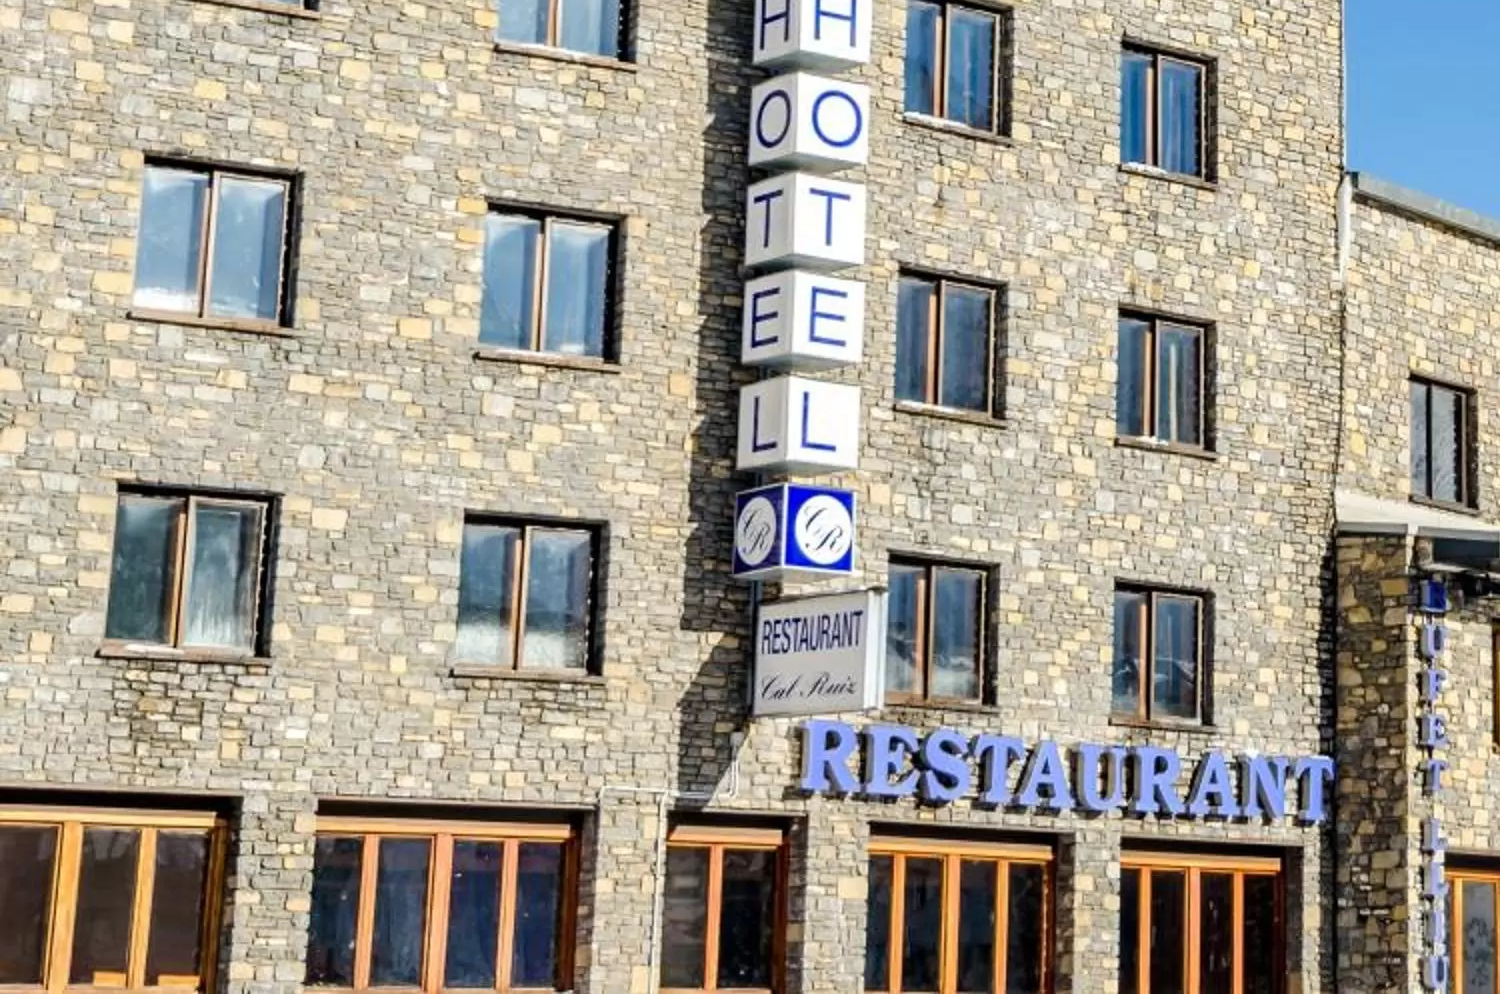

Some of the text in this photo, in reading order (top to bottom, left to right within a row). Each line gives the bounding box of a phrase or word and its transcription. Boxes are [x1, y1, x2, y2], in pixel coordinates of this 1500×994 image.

[761, 610, 864, 656] RESTAURANT
[761, 671, 857, 701] Cal Ruiz
[800, 718, 1335, 823] RESTAURANT
